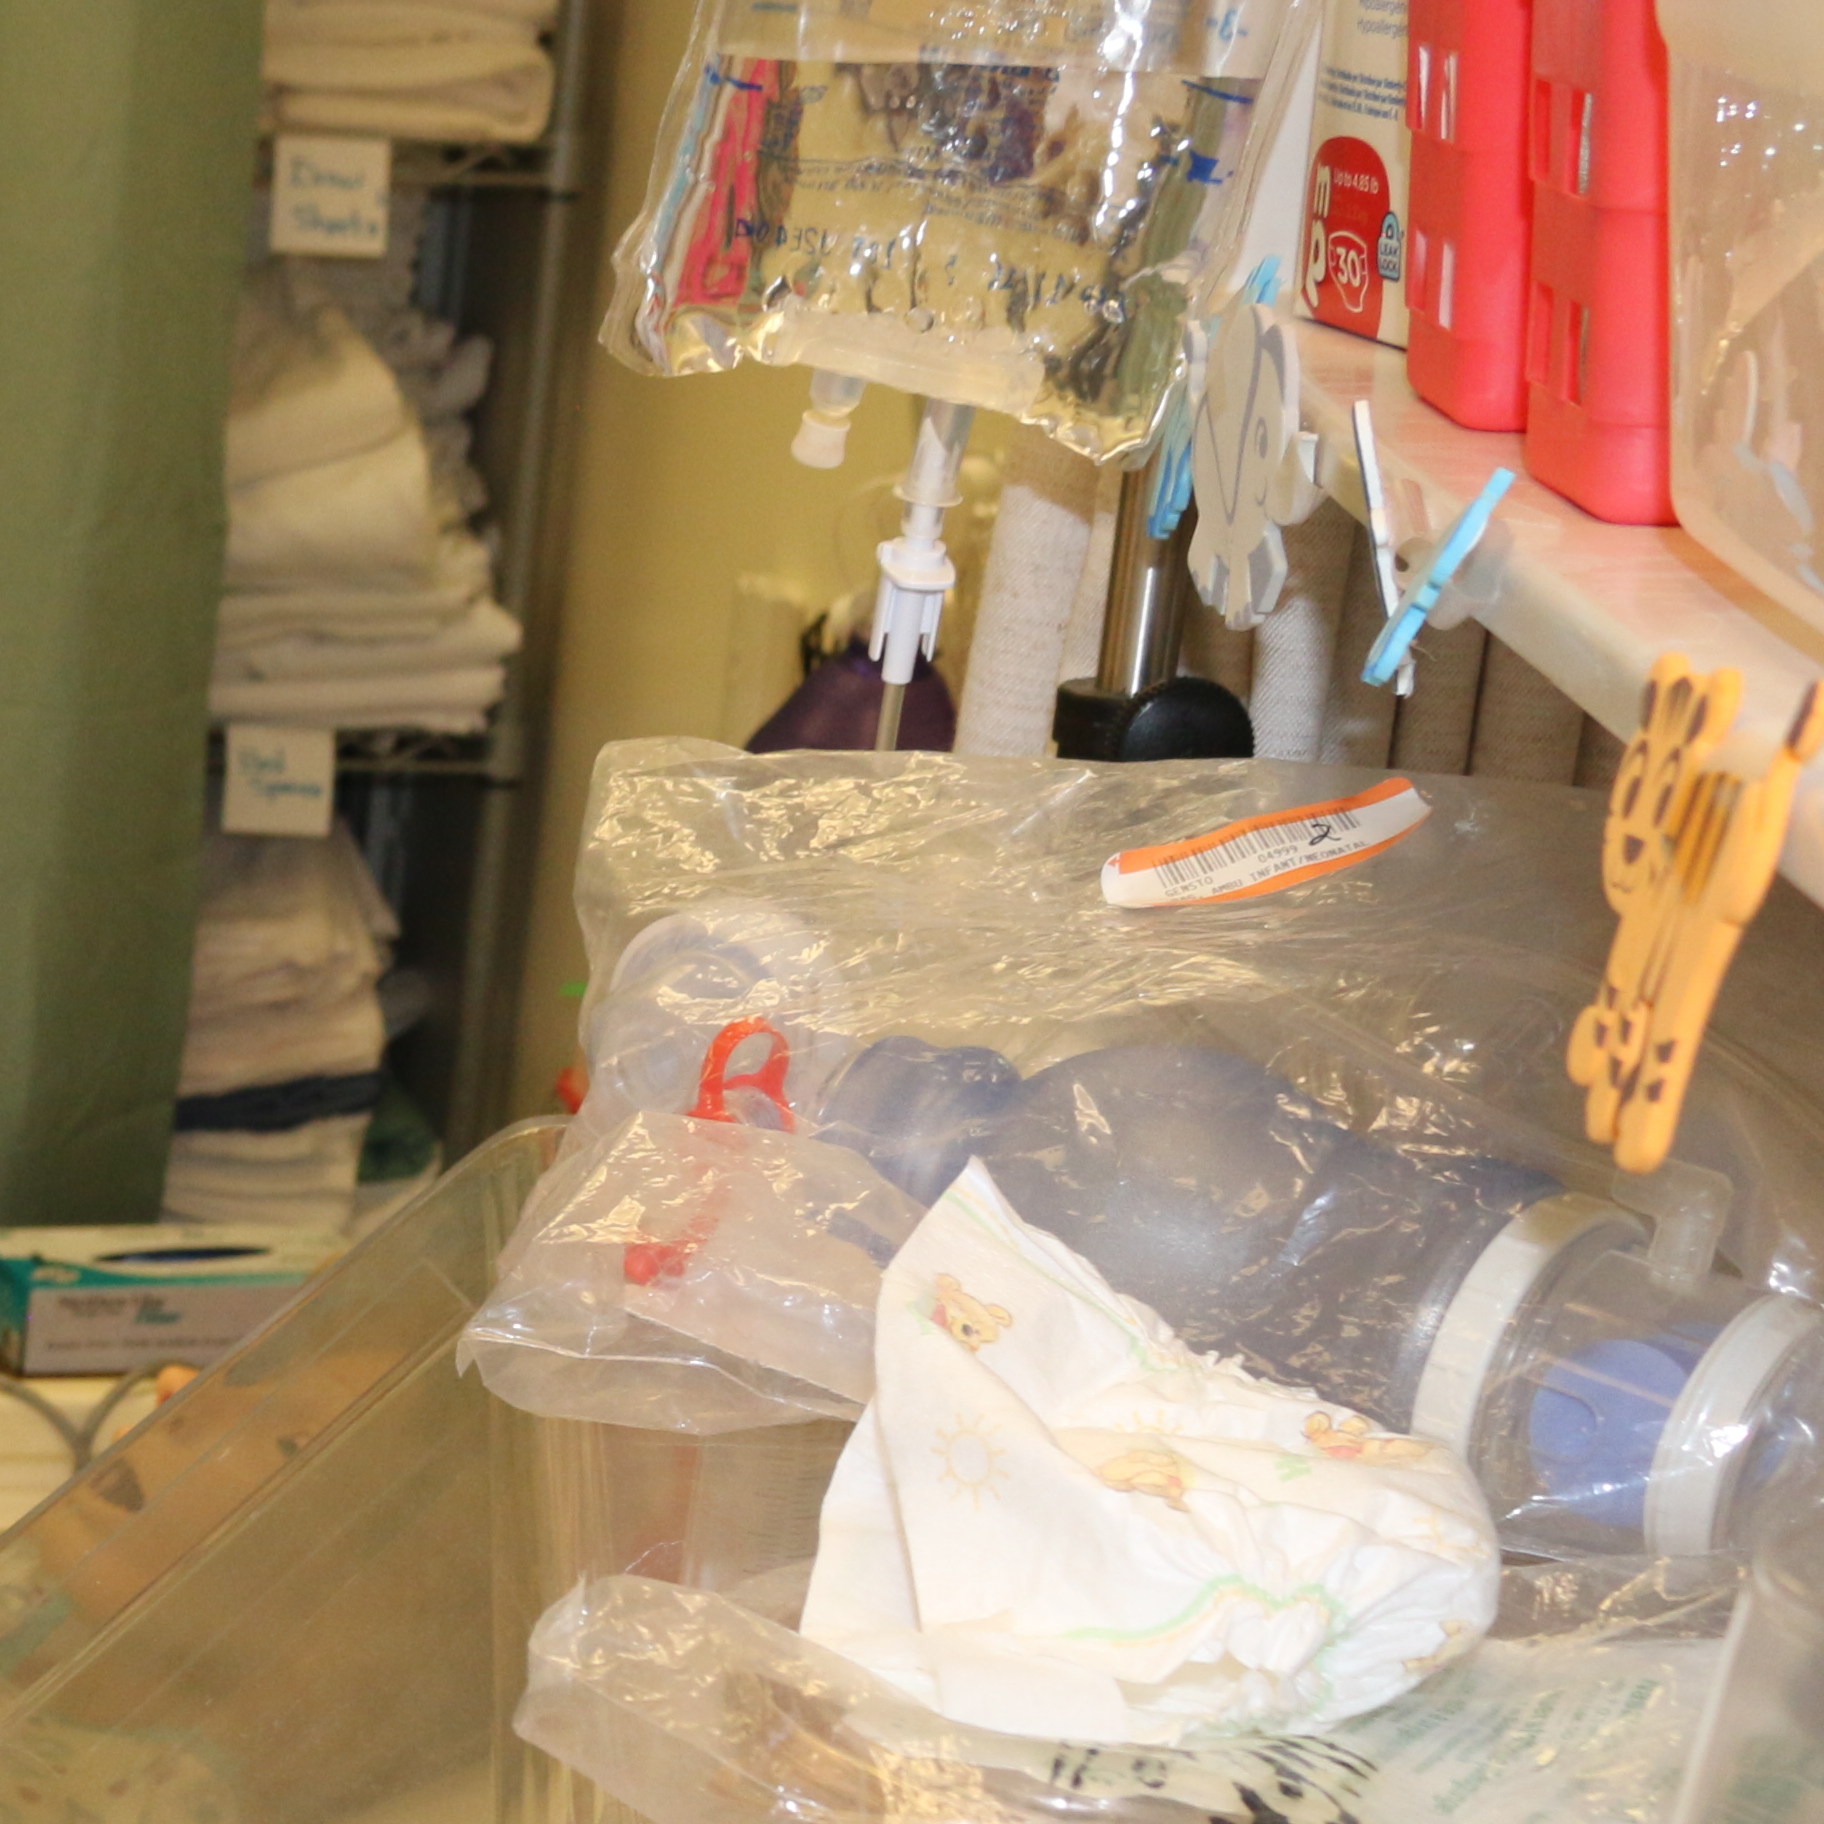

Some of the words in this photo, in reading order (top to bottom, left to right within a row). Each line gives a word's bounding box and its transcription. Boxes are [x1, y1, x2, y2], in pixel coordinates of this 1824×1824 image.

[1379, 242, 1400, 257] LEAK
[1336, 247, 1361, 288] 30
[1379, 259, 1399, 273] LOCK
[1257, 845, 1299, 864] 04999
